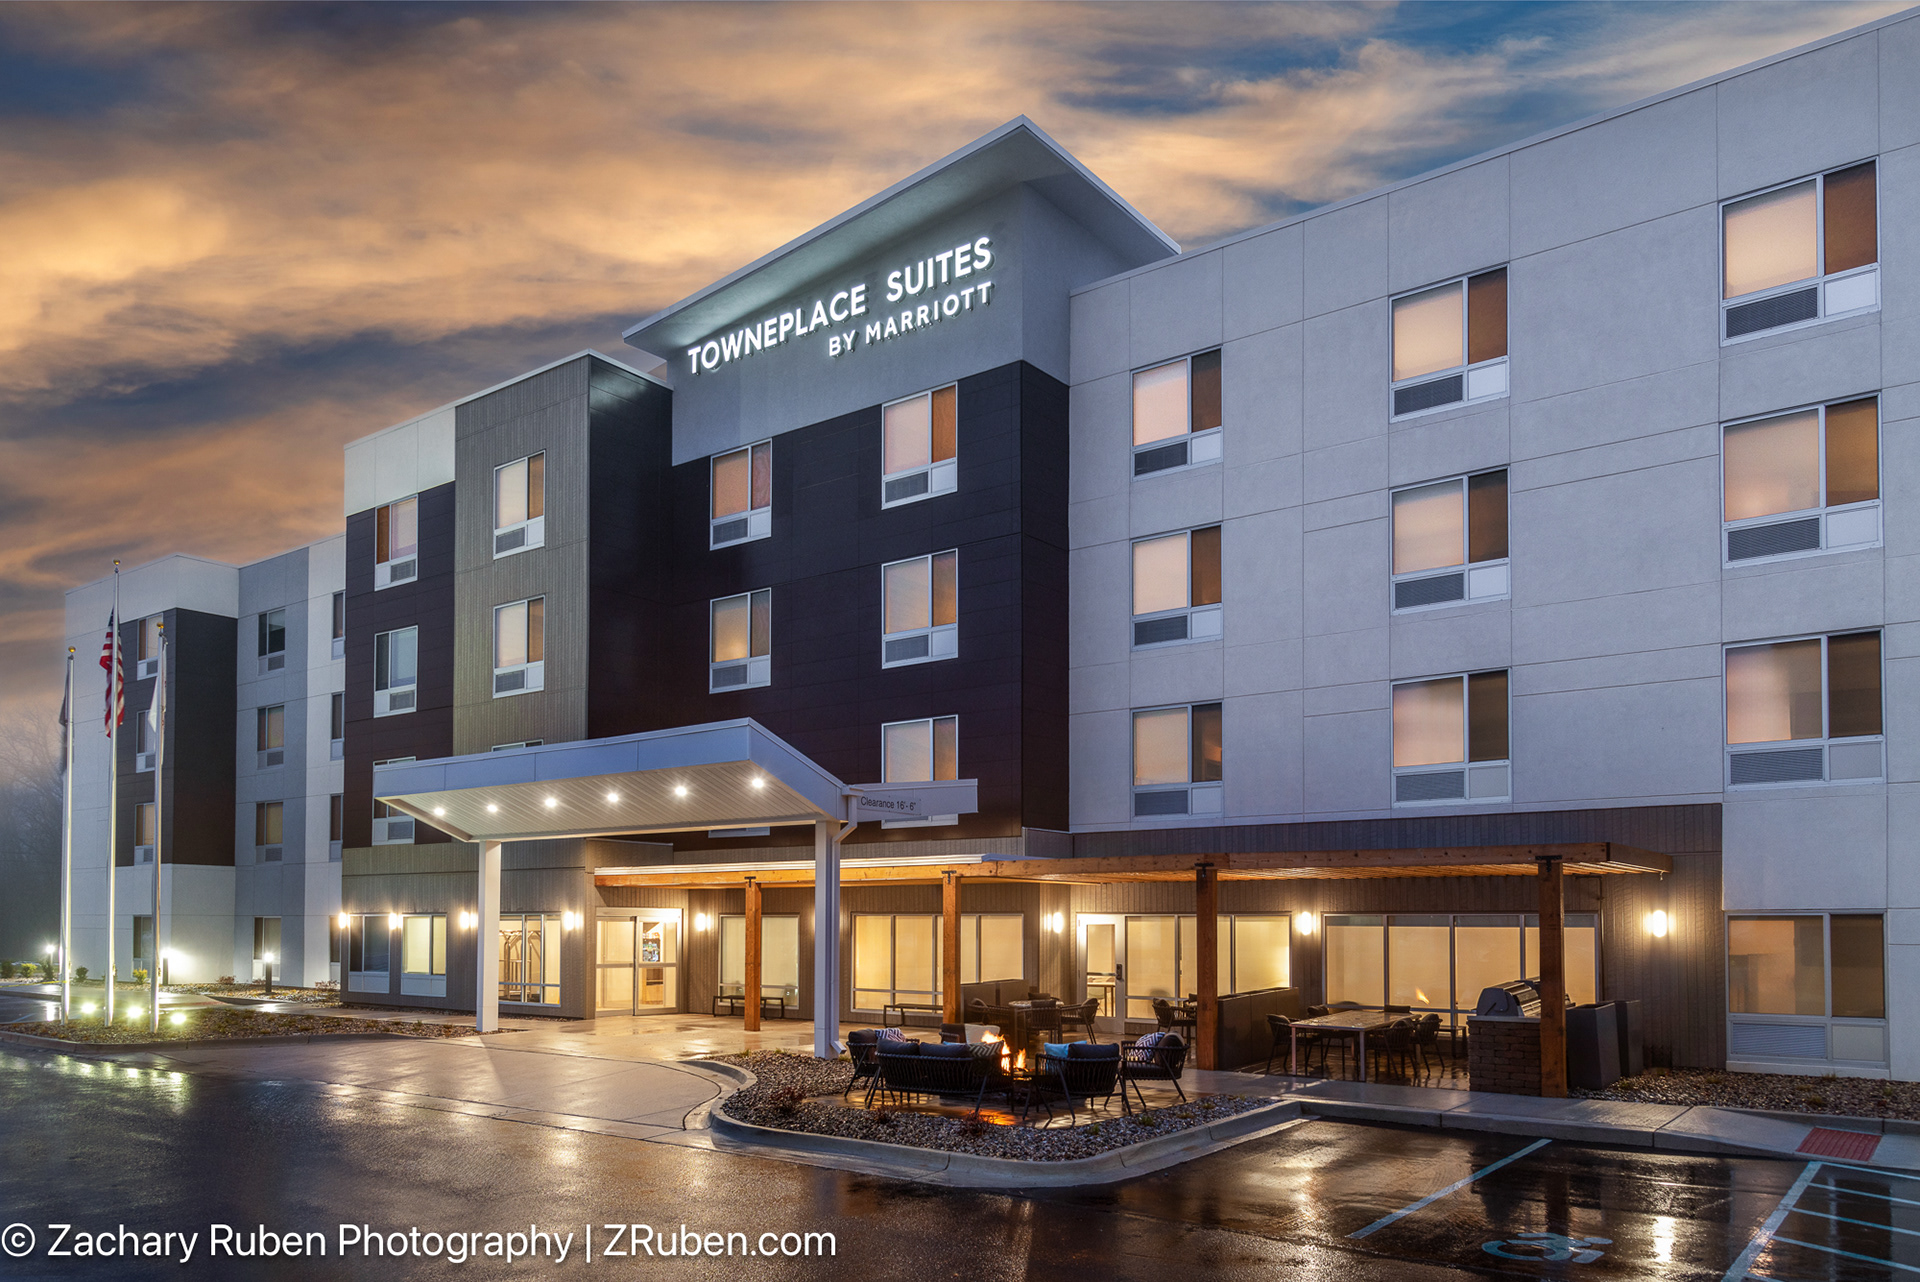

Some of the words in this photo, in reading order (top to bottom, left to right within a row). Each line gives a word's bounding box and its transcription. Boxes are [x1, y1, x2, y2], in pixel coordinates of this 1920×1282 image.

[687, 283, 867, 374] TOWNEPLACE
[886, 237, 992, 303] SUITES
[828, 329, 856, 358] BY
[865, 281, 992, 344] MARRIOTT
[860, 796, 895, 809] Clearance
